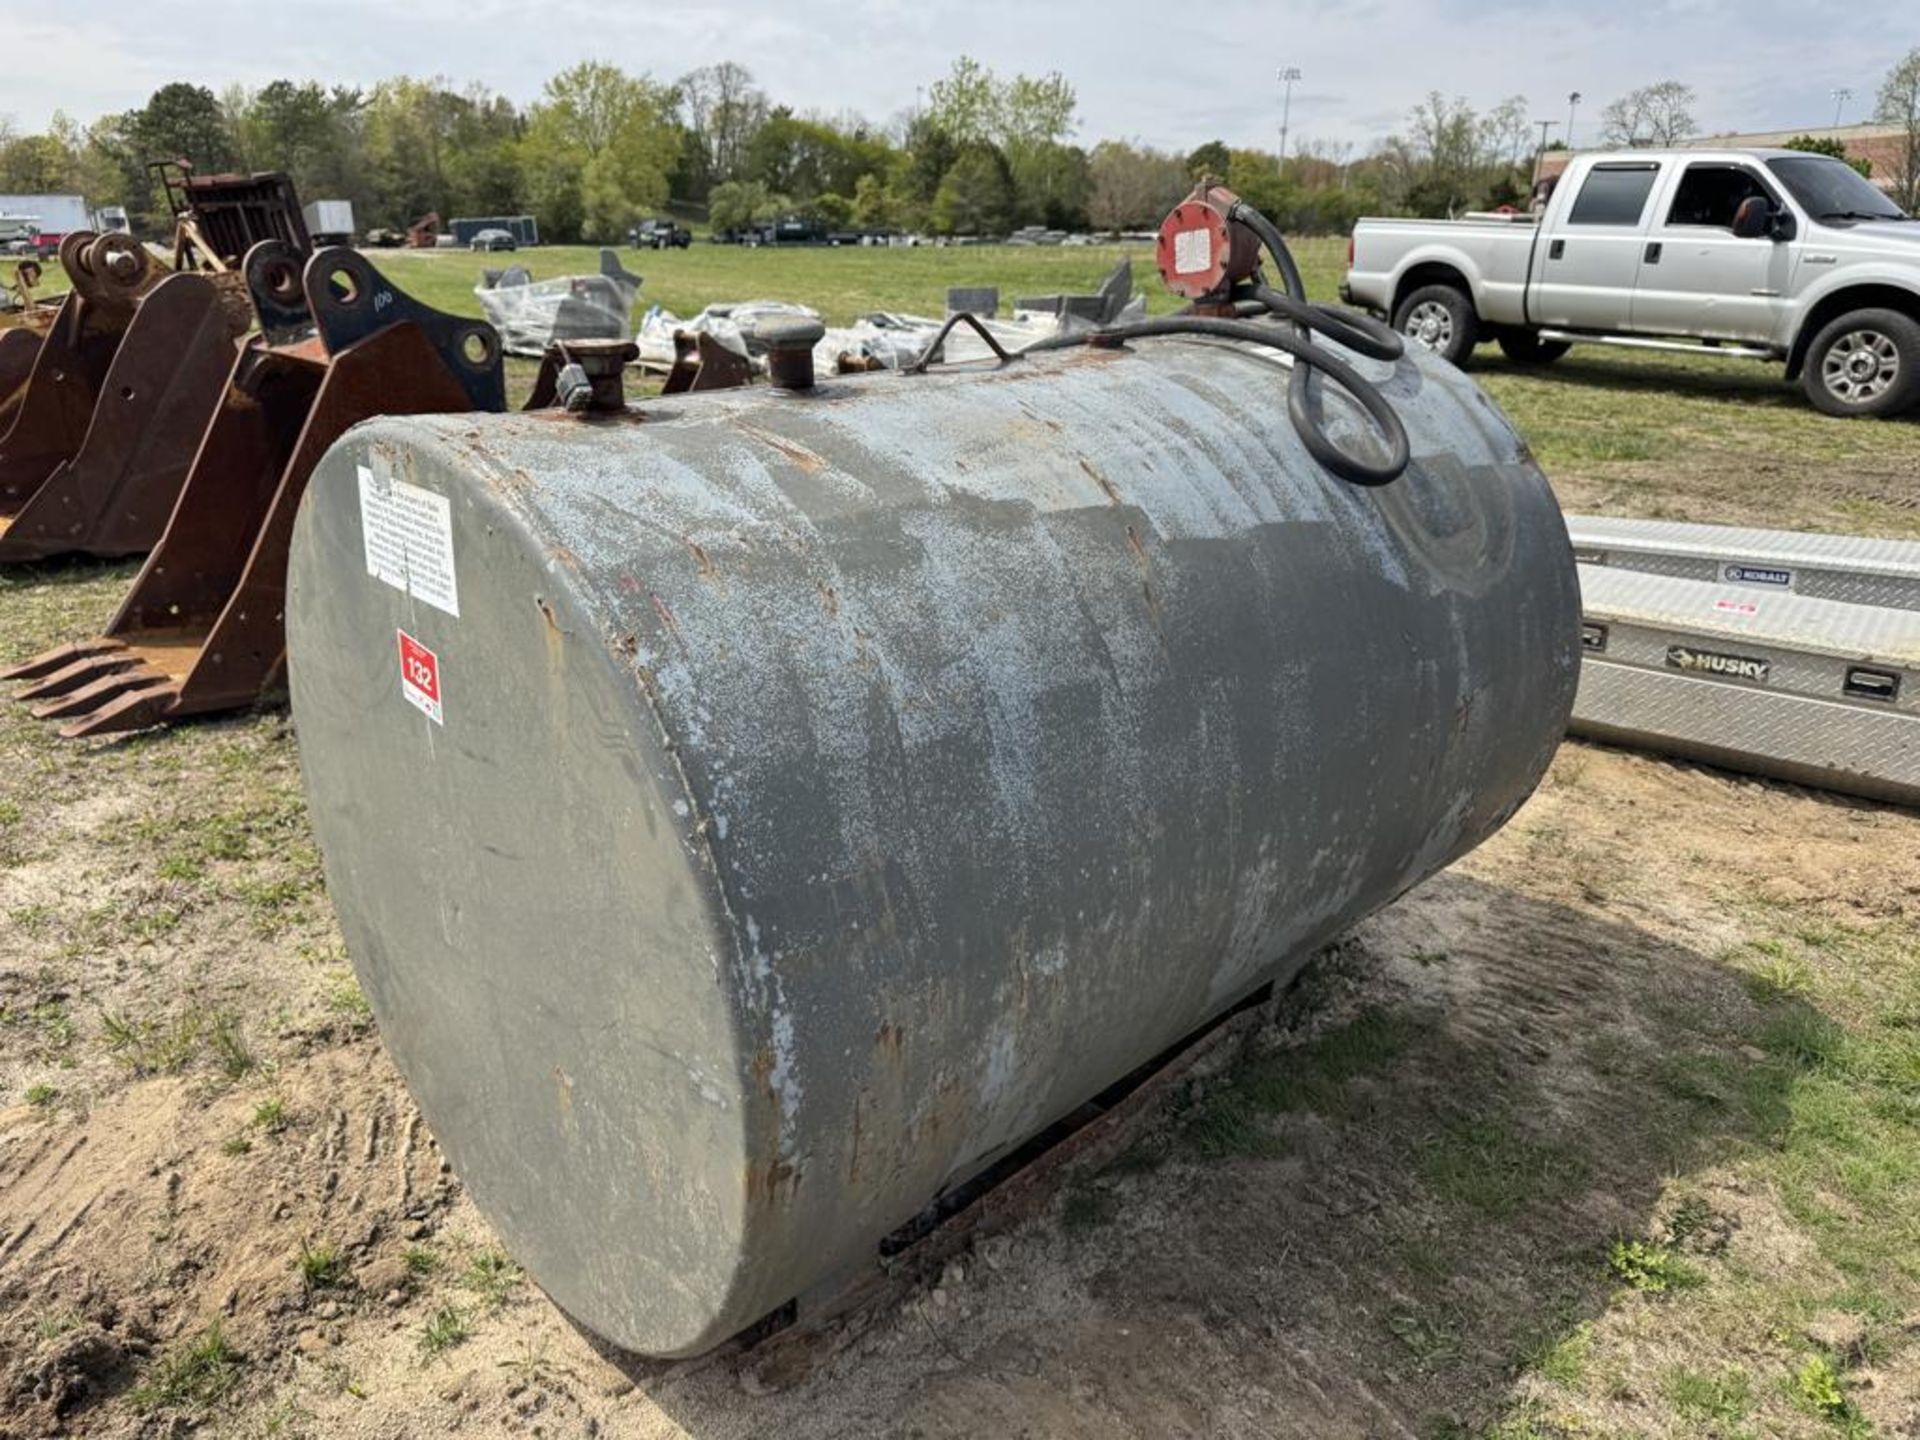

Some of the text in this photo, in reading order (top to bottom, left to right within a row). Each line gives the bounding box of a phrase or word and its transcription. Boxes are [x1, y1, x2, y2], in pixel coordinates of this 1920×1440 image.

[1743, 570, 1788, 582] KOBALT
[408, 657, 433, 691] 132
[1696, 653, 1767, 679] HUSKY
